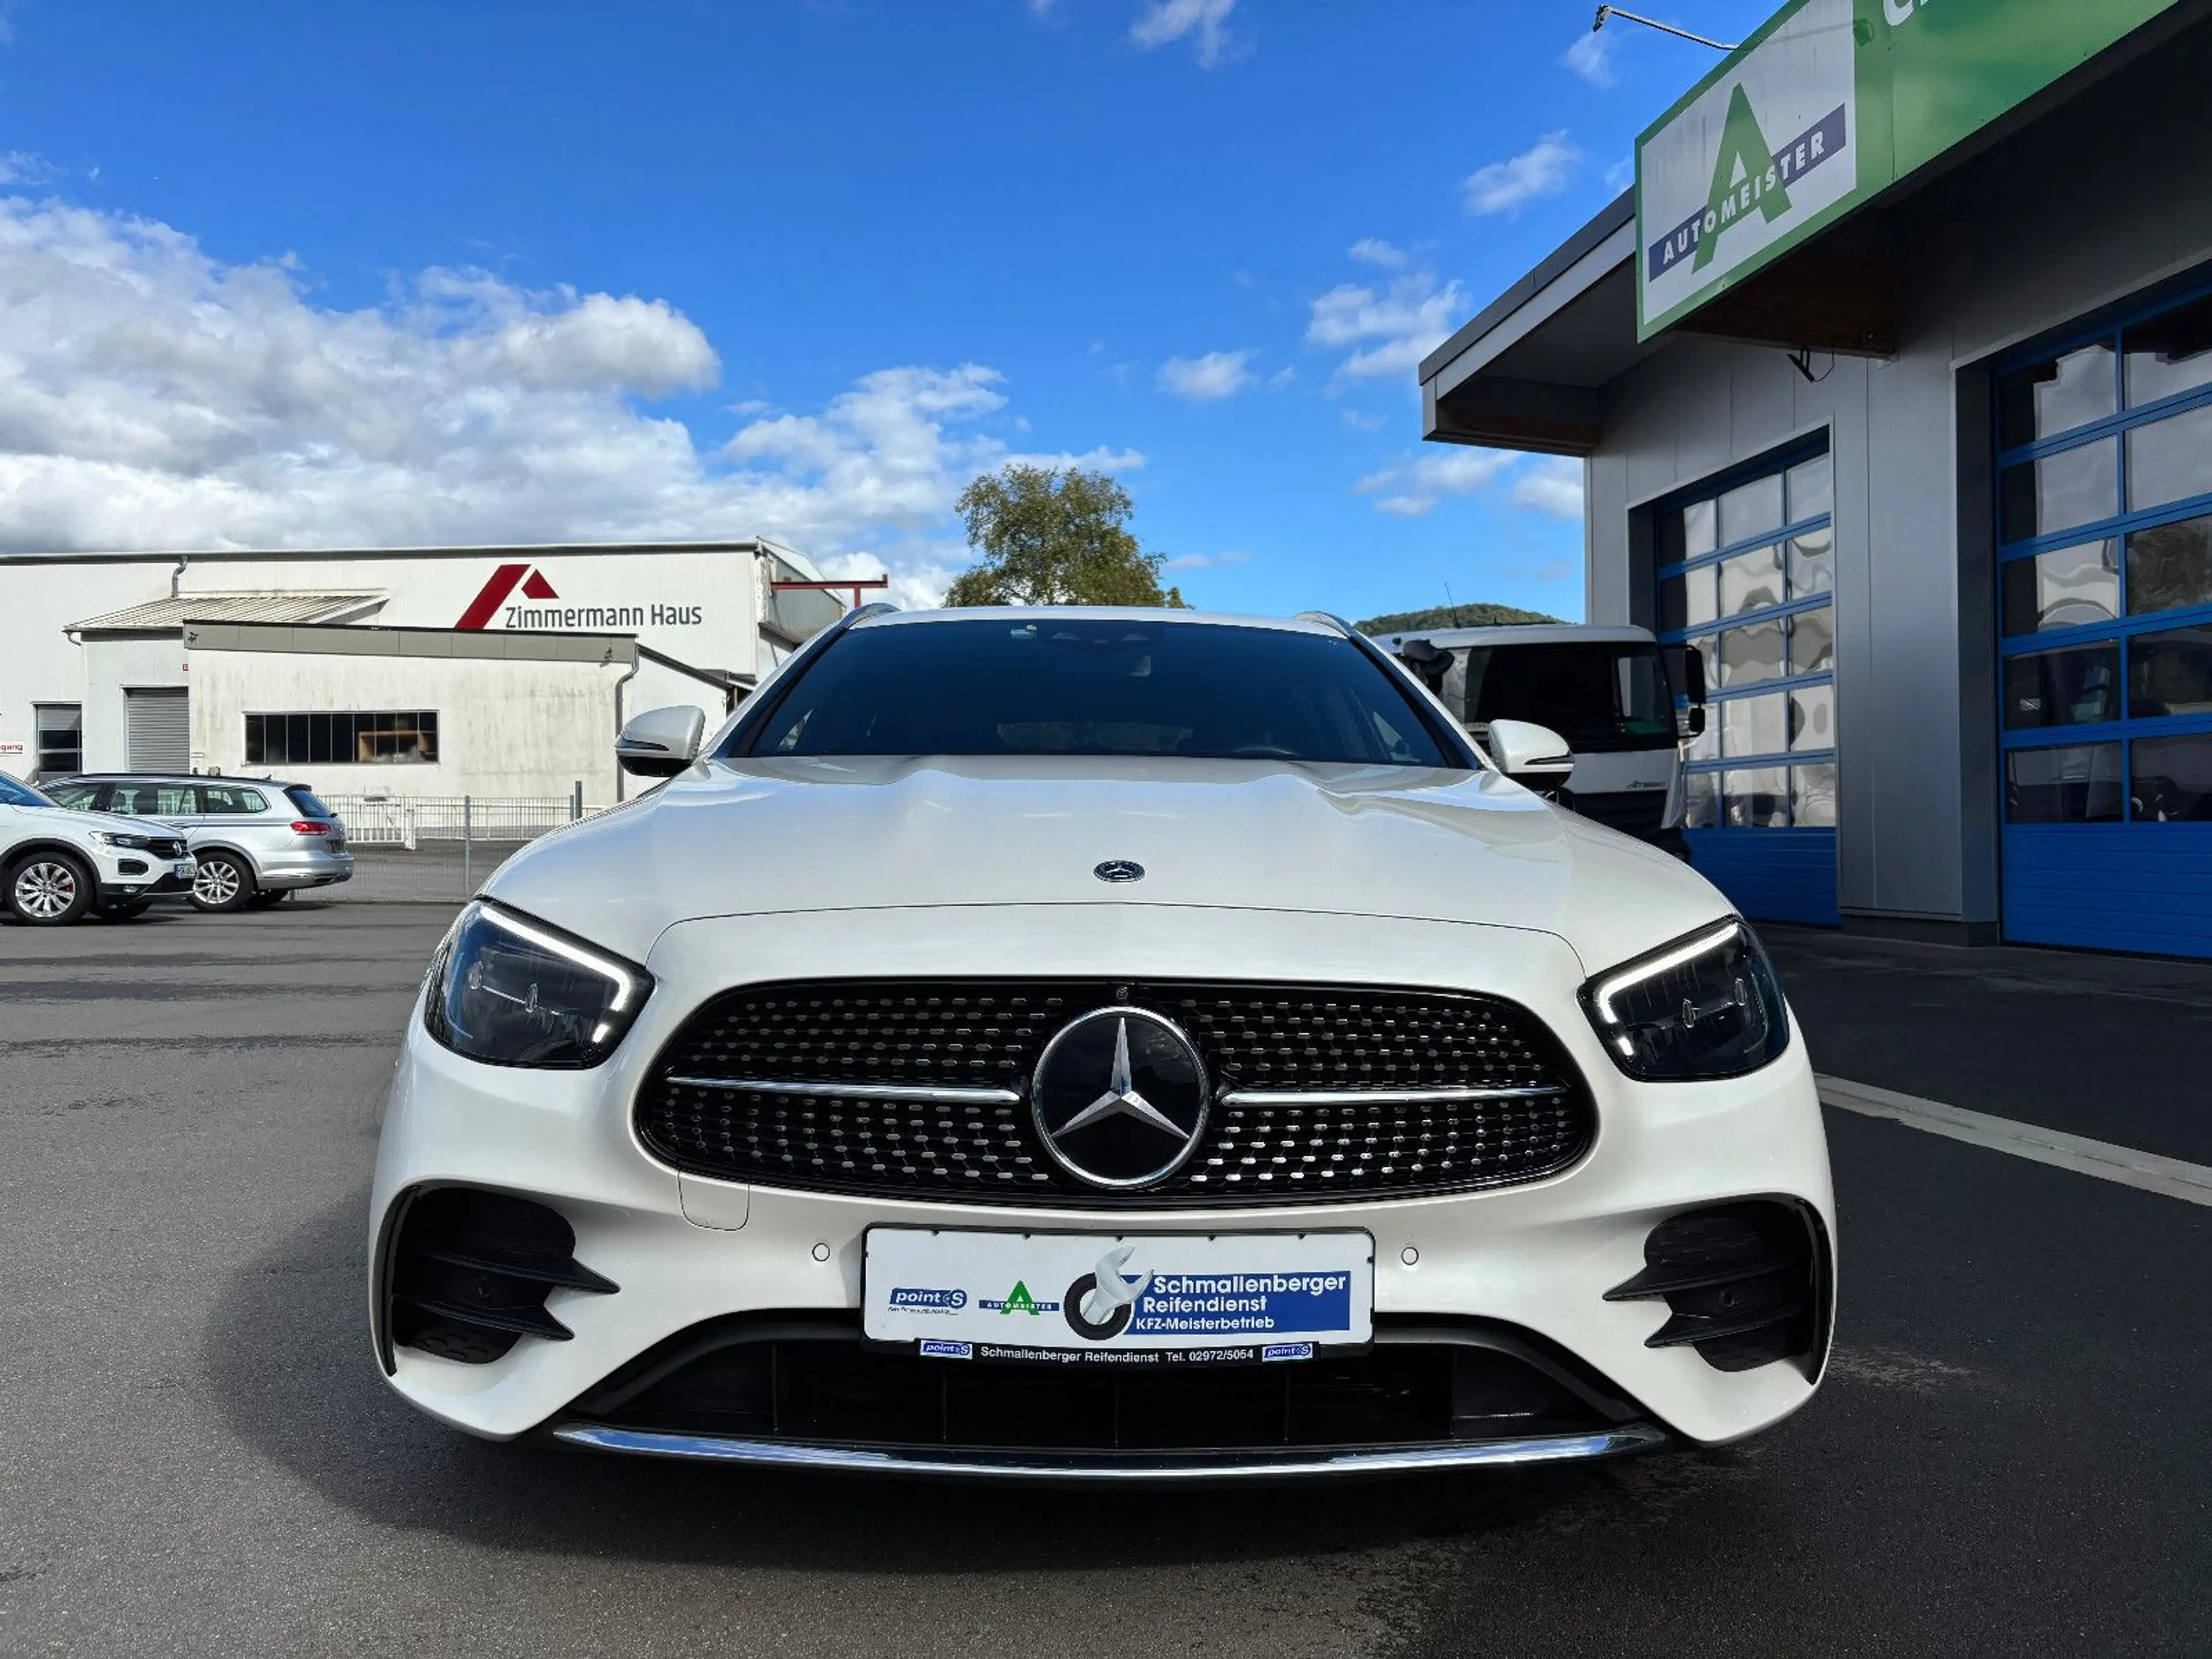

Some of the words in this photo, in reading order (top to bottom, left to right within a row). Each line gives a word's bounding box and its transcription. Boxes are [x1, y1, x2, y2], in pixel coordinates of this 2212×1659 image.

[1662, 131, 1825, 265] AUTOMEISTER
[505, 605, 644, 628] Zimmermann
[651, 604, 702, 626] Haus
[1153, 1274, 1347, 1296] Schmallenberger
[1143, 1295, 1267, 1313] Reifendienst
[1135, 1316, 1275, 1330] KFZ-Meisterbetrieb
[980, 1346, 1082, 1363] Schmallenberger
[1085, 1351, 1159, 1363] Reifendienst
[1165, 1351, 1185, 1362] Tel.
[1189, 1349, 1254, 1362] 02972/5054
